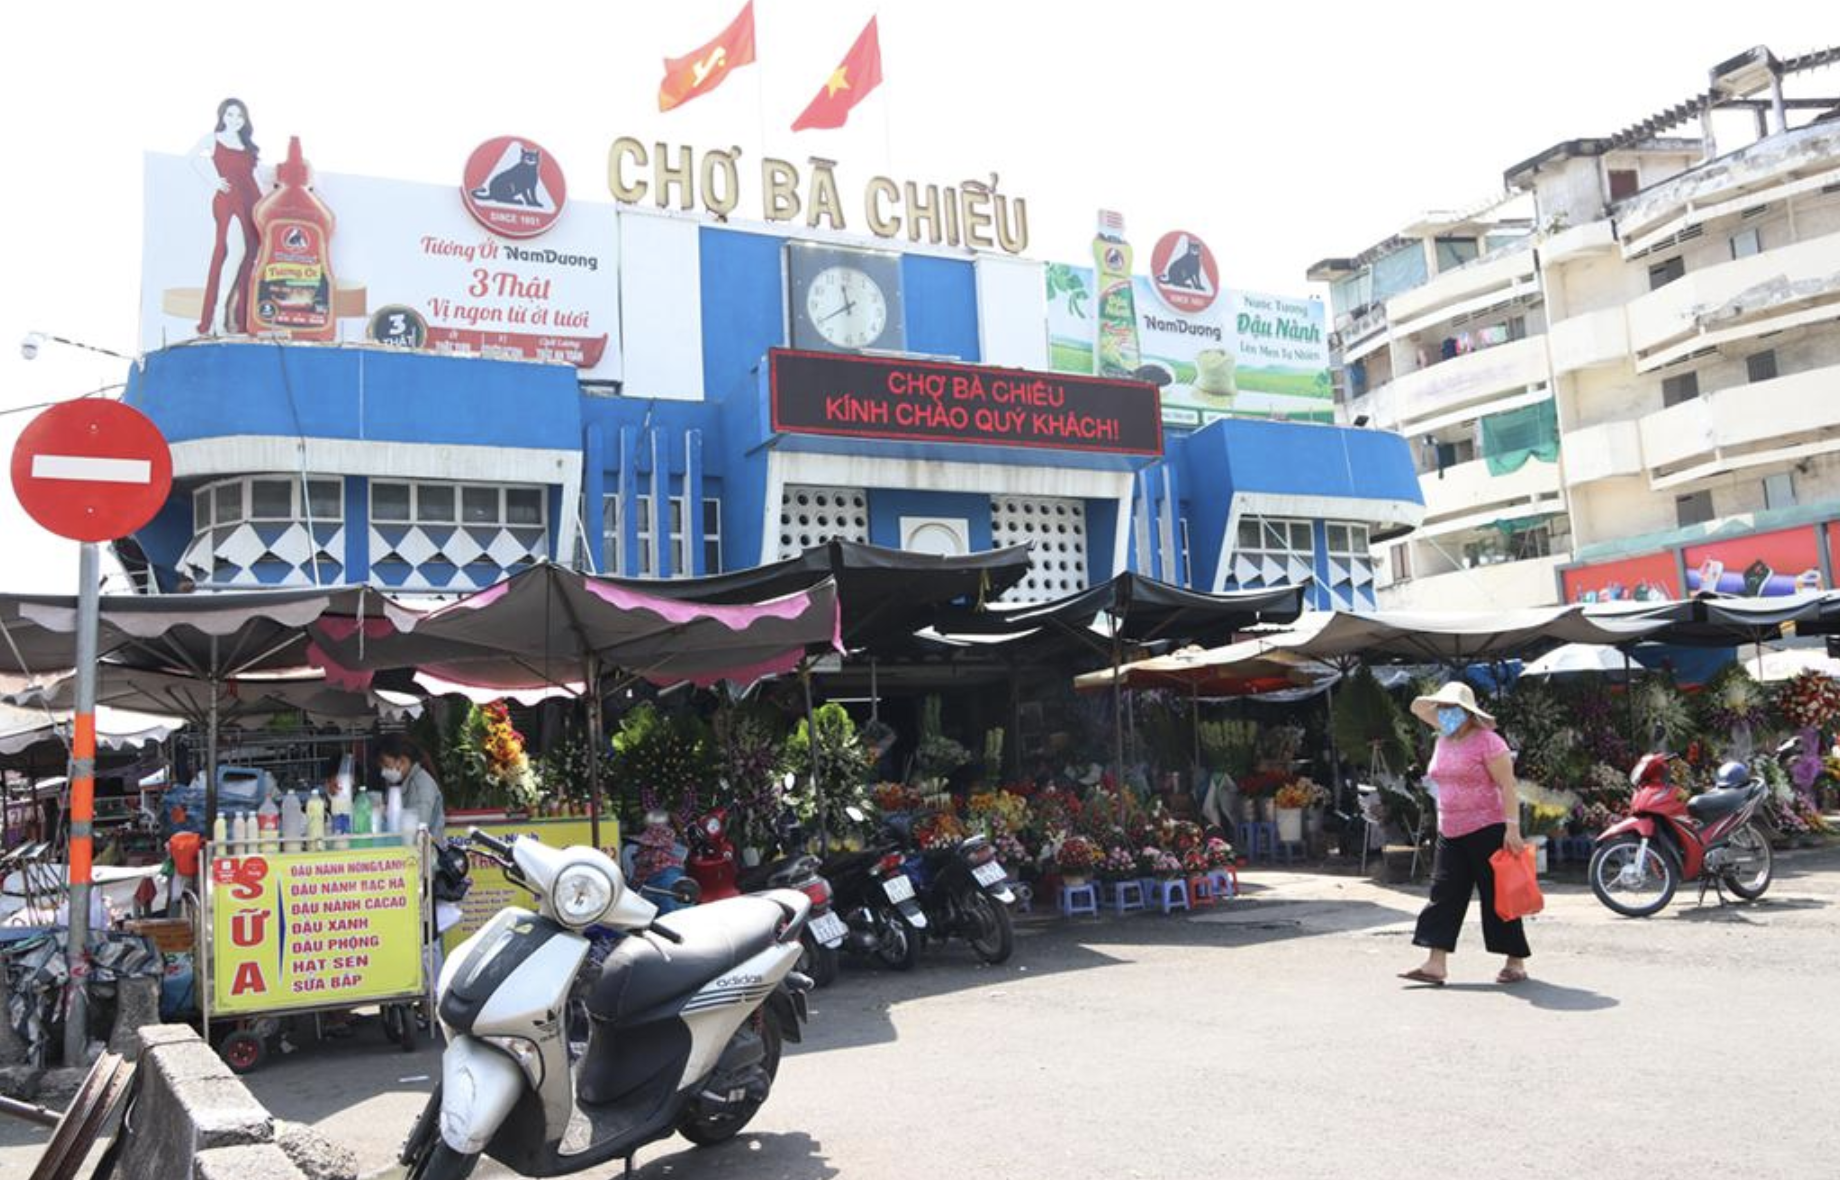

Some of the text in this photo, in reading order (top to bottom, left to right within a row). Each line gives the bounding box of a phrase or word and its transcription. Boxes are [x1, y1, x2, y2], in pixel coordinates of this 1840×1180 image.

[607, 136, 742, 222] CHỢ
[866, 172, 1029, 253] CHIỂU
[468, 268, 489, 298] 3
[388, 313, 407, 335] 3
[453, 304, 503, 326] ngon
[888, 371, 946, 401] CHỢ
[952, 374, 986, 400] BÀ
[825, 394, 1119, 441] KÍNH CHÀO QUÝ KHÁCH!
[291, 883, 317, 897] ĐẬU
[321, 881, 357, 893] NÀNH
[291, 896, 407, 916] ĐẬU NÀNH CACAO
[292, 918, 368, 936] ĐẬU XANH
[292, 940, 323, 955] ĐẬU
[293, 955, 369, 975] HẠT SEN
[716, 972, 763, 987] adidas
